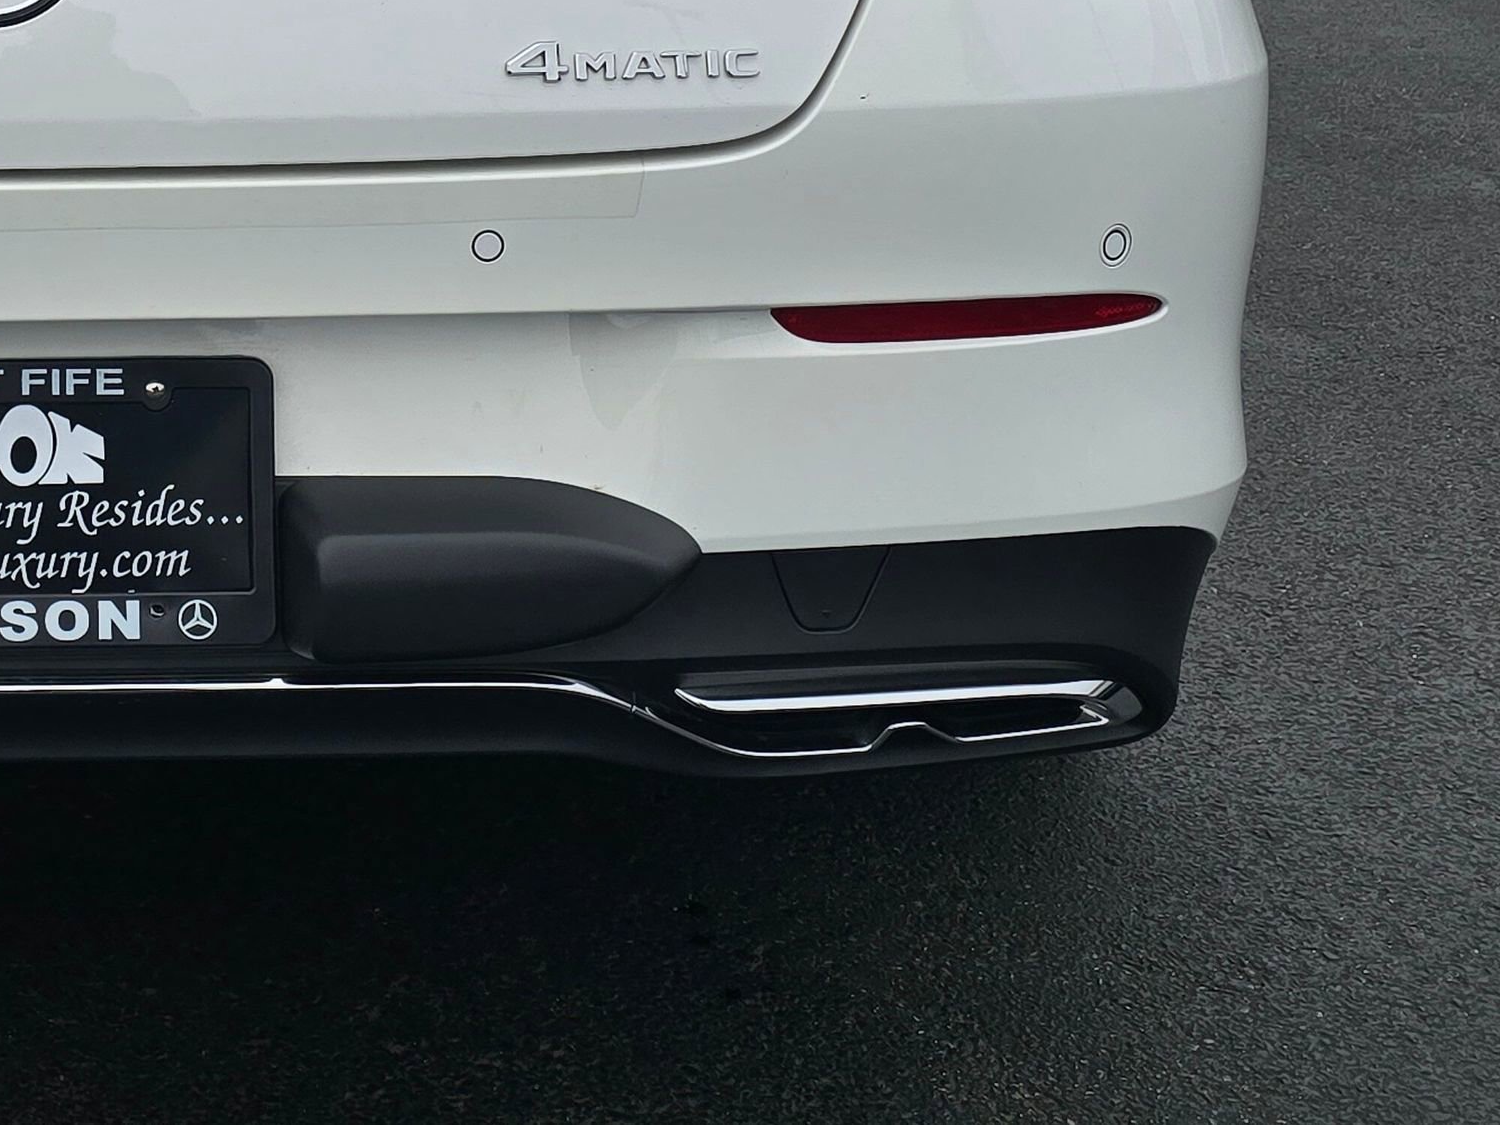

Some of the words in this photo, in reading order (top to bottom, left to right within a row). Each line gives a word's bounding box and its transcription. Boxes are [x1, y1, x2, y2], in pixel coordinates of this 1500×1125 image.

[504, 40, 761, 83] 4MATIC
[20, 368, 125, 396] FIFE
[57, 484, 244, 536] Resides...
